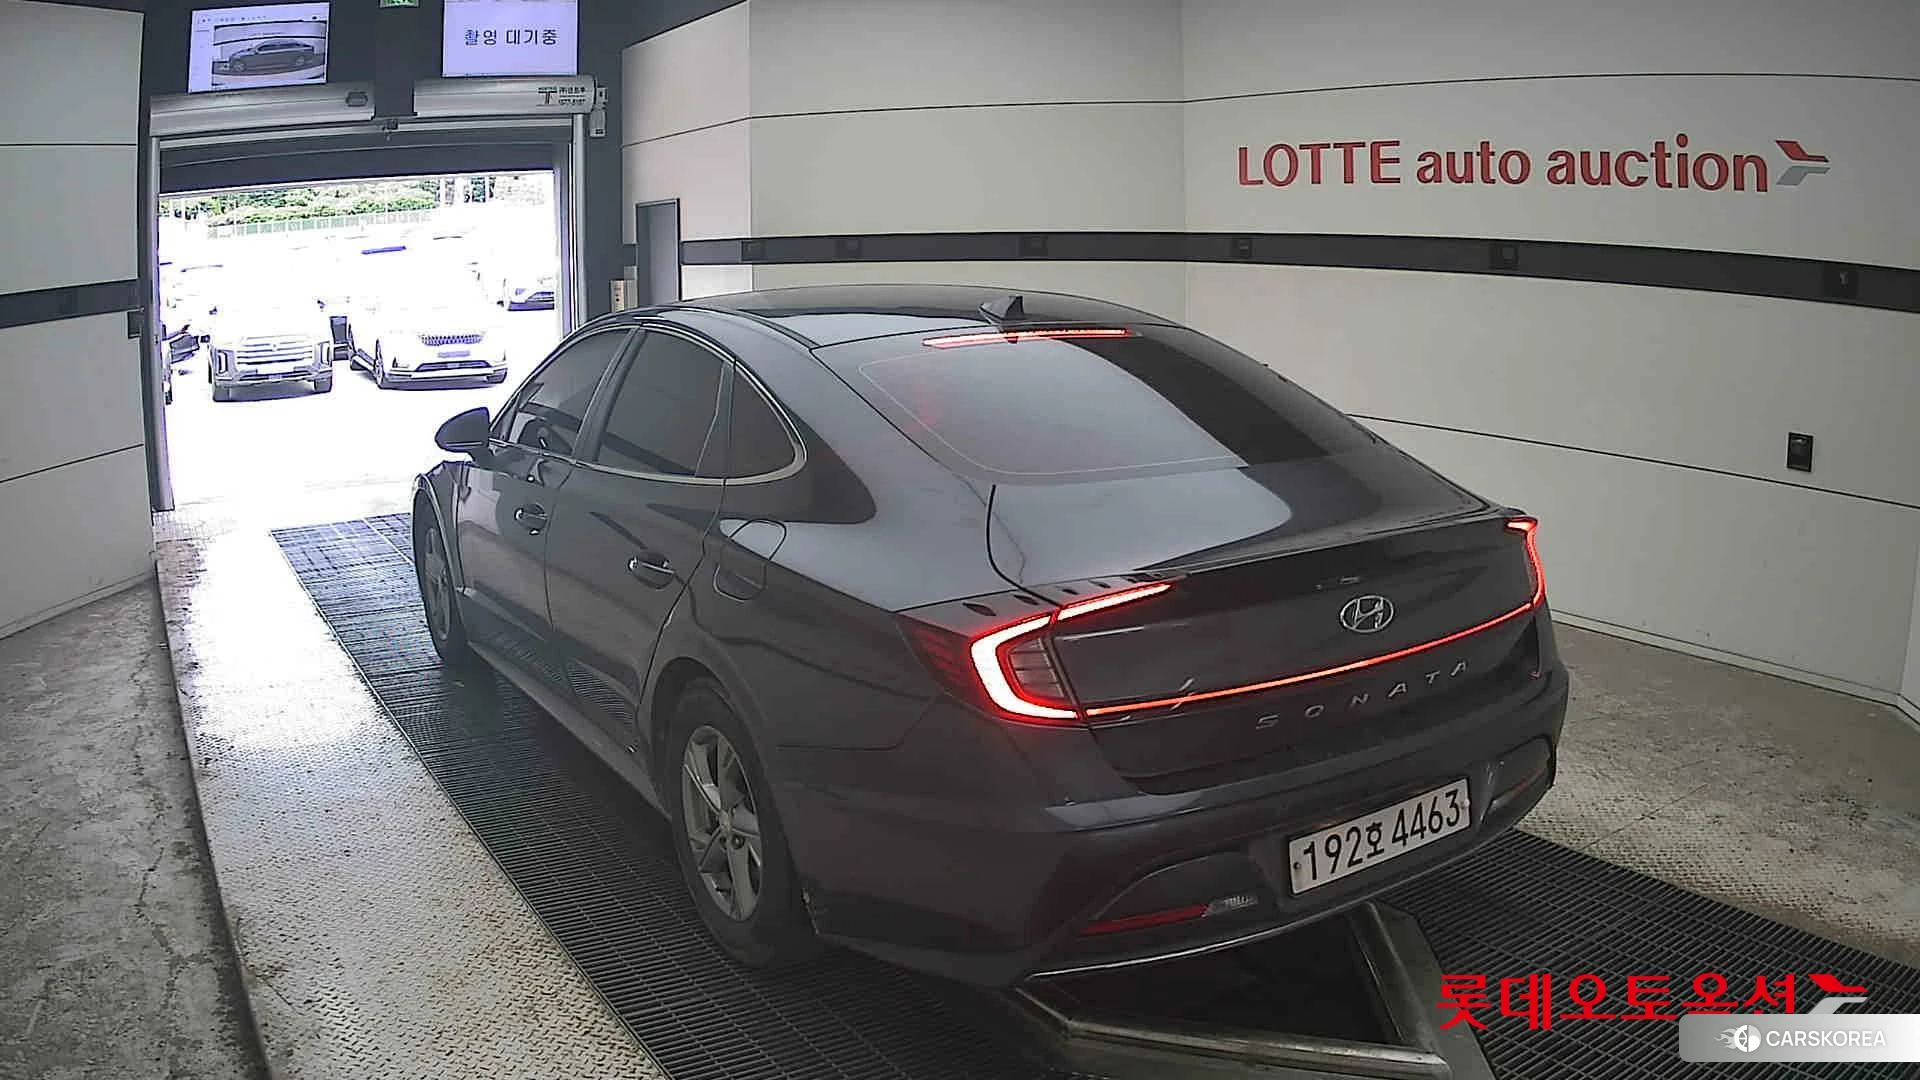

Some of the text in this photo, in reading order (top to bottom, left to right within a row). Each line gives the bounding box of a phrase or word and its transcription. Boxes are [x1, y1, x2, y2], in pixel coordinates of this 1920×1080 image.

[464, 29, 557, 46] 촬영 대기중
[1239, 133, 1768, 192] LOTTE auto auction
[1255, 661, 1467, 730] SONATA
[1391, 788, 1461, 847] 4463
